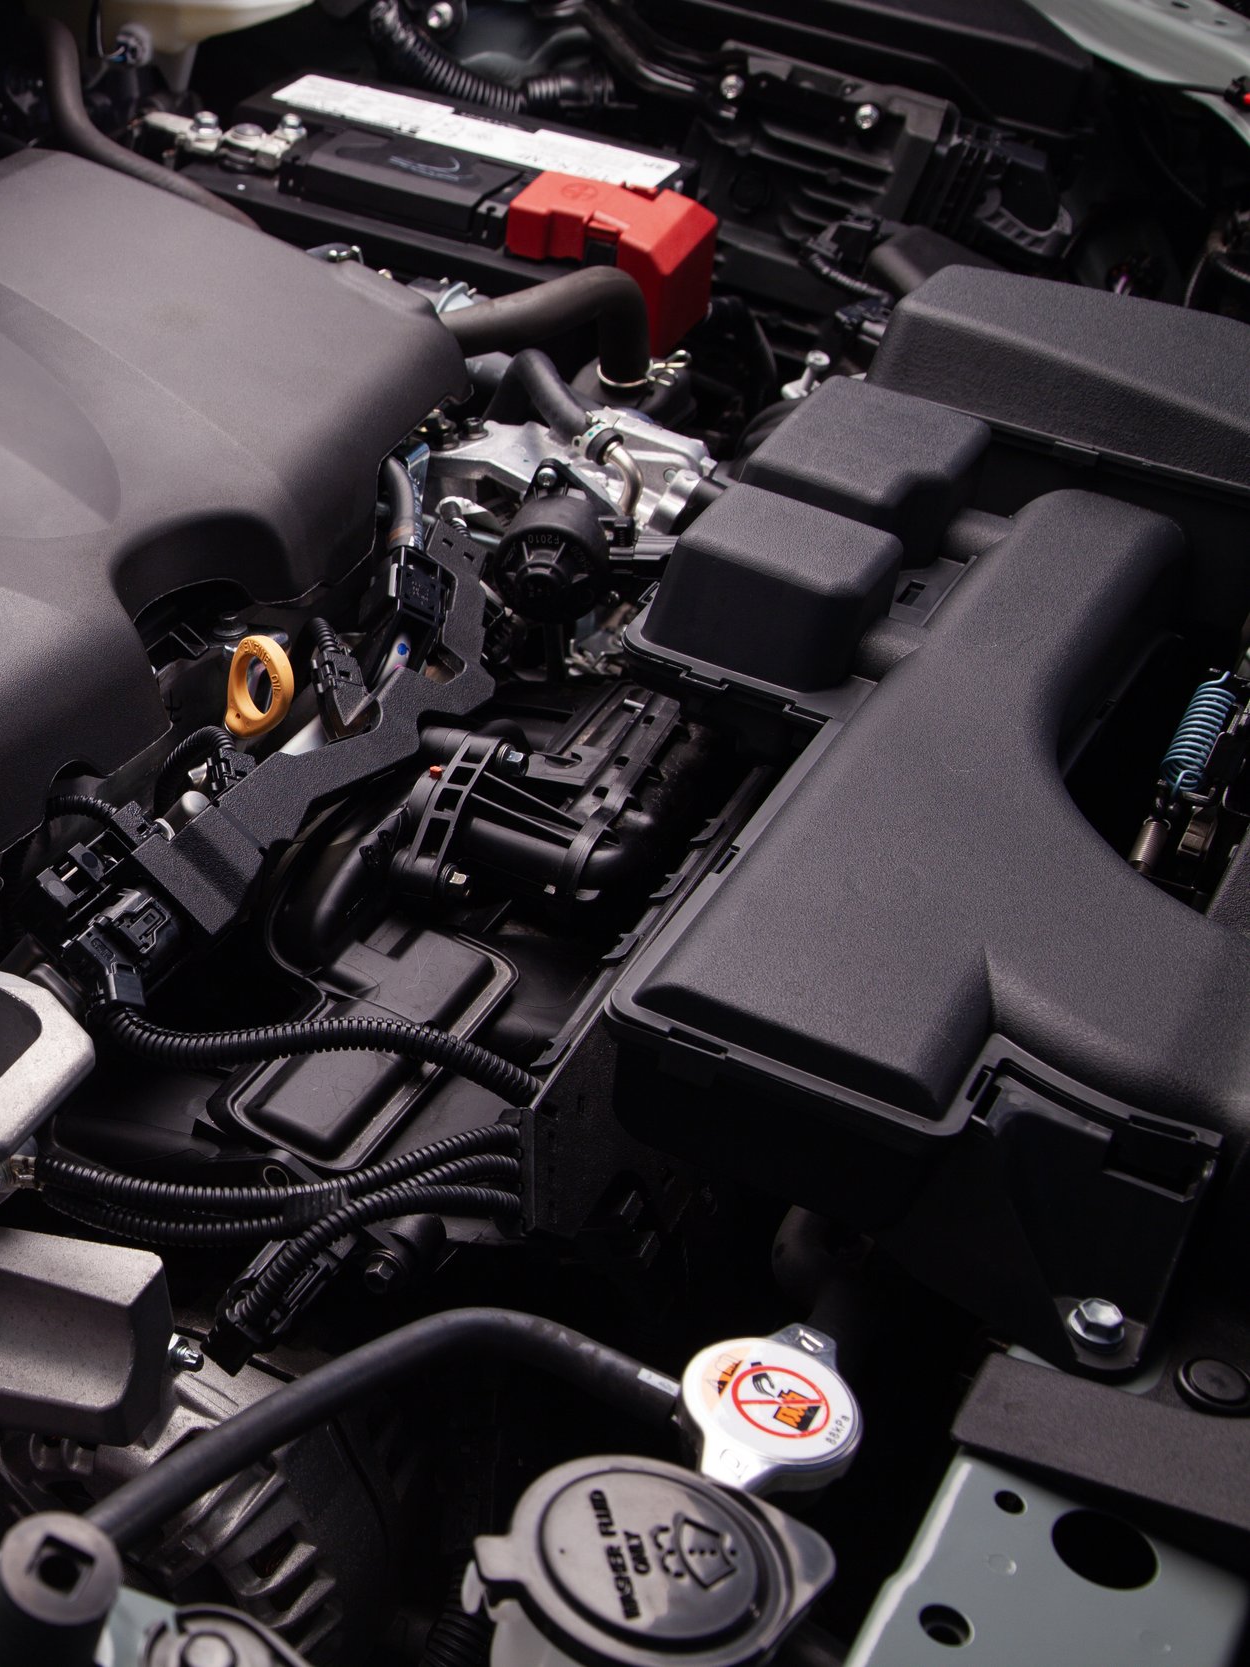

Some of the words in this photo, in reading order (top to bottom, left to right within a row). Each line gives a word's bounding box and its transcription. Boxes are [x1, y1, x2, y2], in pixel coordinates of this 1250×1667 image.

[243, 640, 271, 665] ENGINE
[271, 674, 282, 697] OIL
[589, 1490, 617, 1537] FLUID
[623, 1530, 651, 1574] ONLY
[605, 1545, 640, 1619] WASHER
